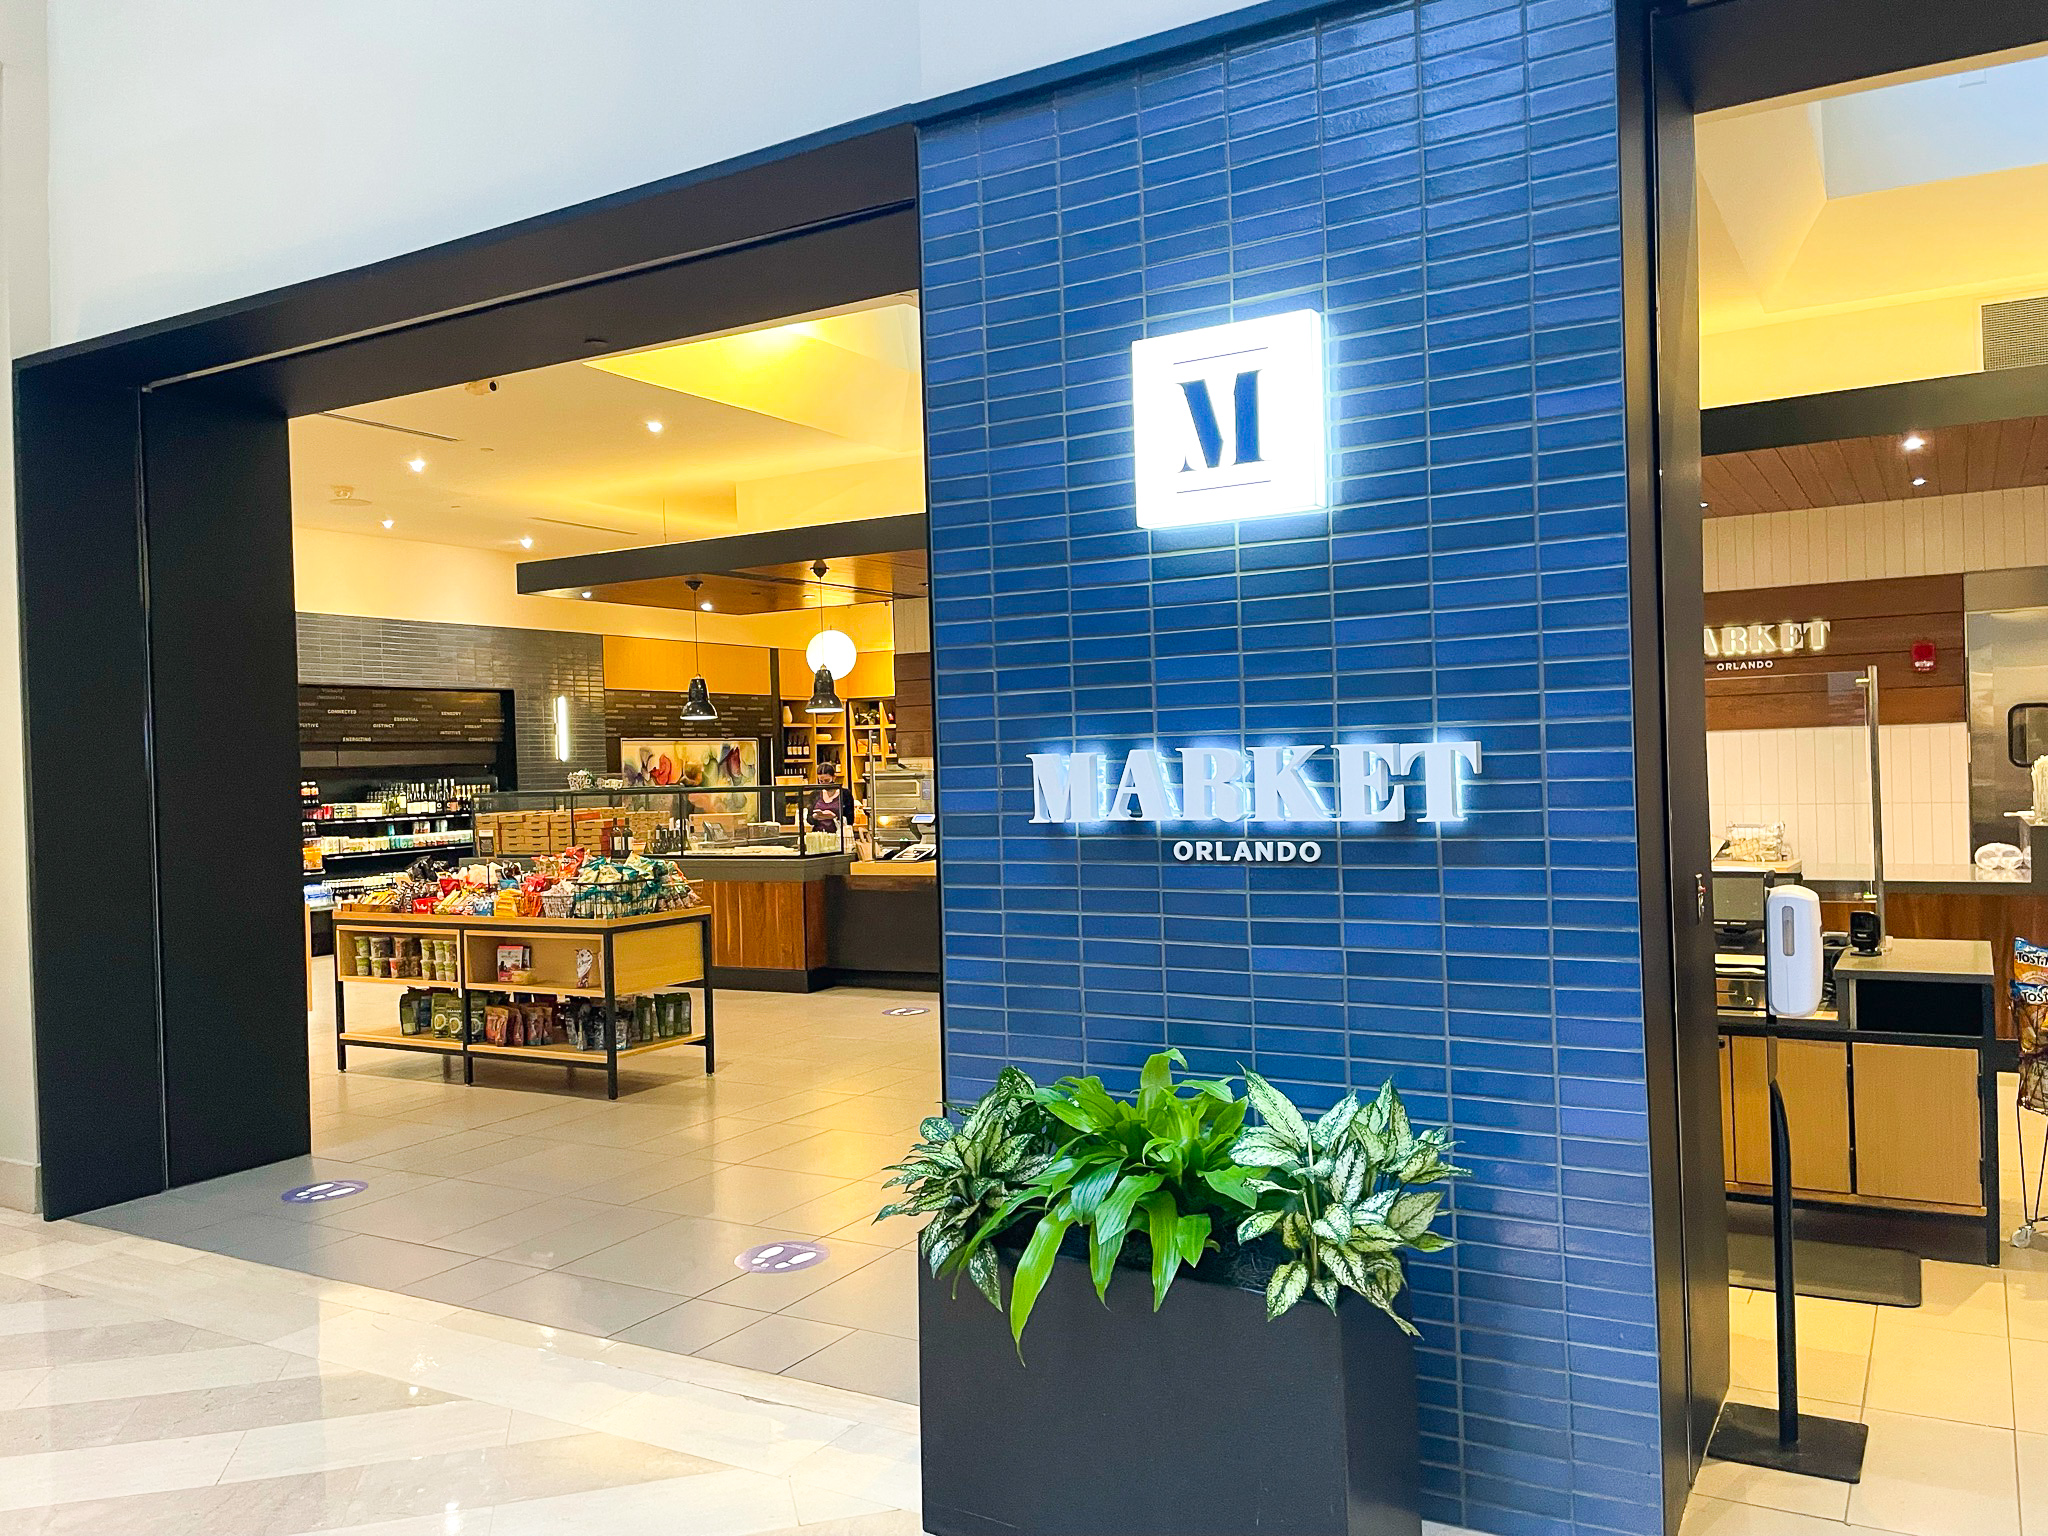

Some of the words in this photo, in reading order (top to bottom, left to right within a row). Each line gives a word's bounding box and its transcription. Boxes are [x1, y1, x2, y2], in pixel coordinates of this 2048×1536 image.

[1175, 368, 1271, 474] M
[1716, 660, 1774, 671] ORLANDO
[1025, 740, 1482, 824] MARKET
[1173, 840, 1322, 863] ORLANDO
